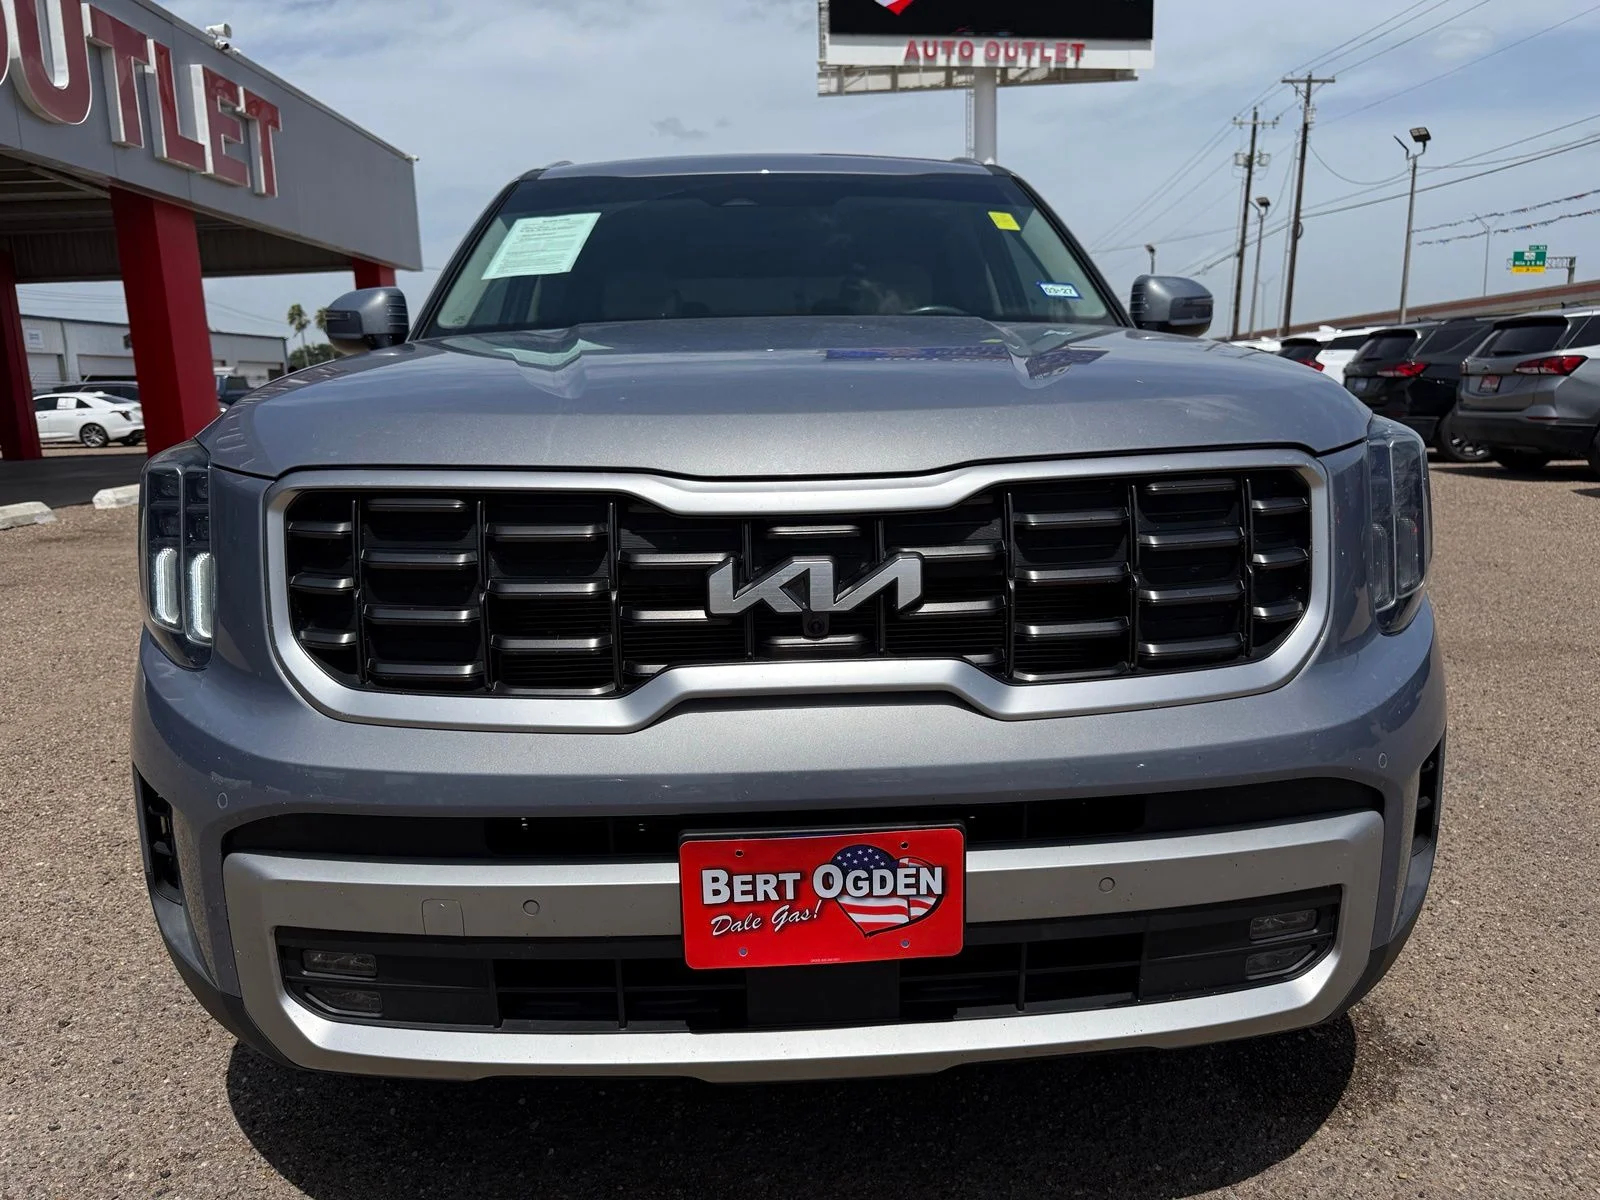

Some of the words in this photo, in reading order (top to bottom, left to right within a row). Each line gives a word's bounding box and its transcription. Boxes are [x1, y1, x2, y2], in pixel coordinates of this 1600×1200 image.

[904, 40, 975, 62] AUTO
[984, 40, 1086, 63] OUTLET
[0, 0, 283, 198] UTLET
[701, 868, 801, 905] BERT
[812, 863, 943, 899] OGDEN
[710, 912, 763, 936] Dale
[771, 899, 823, 932] Gas!
